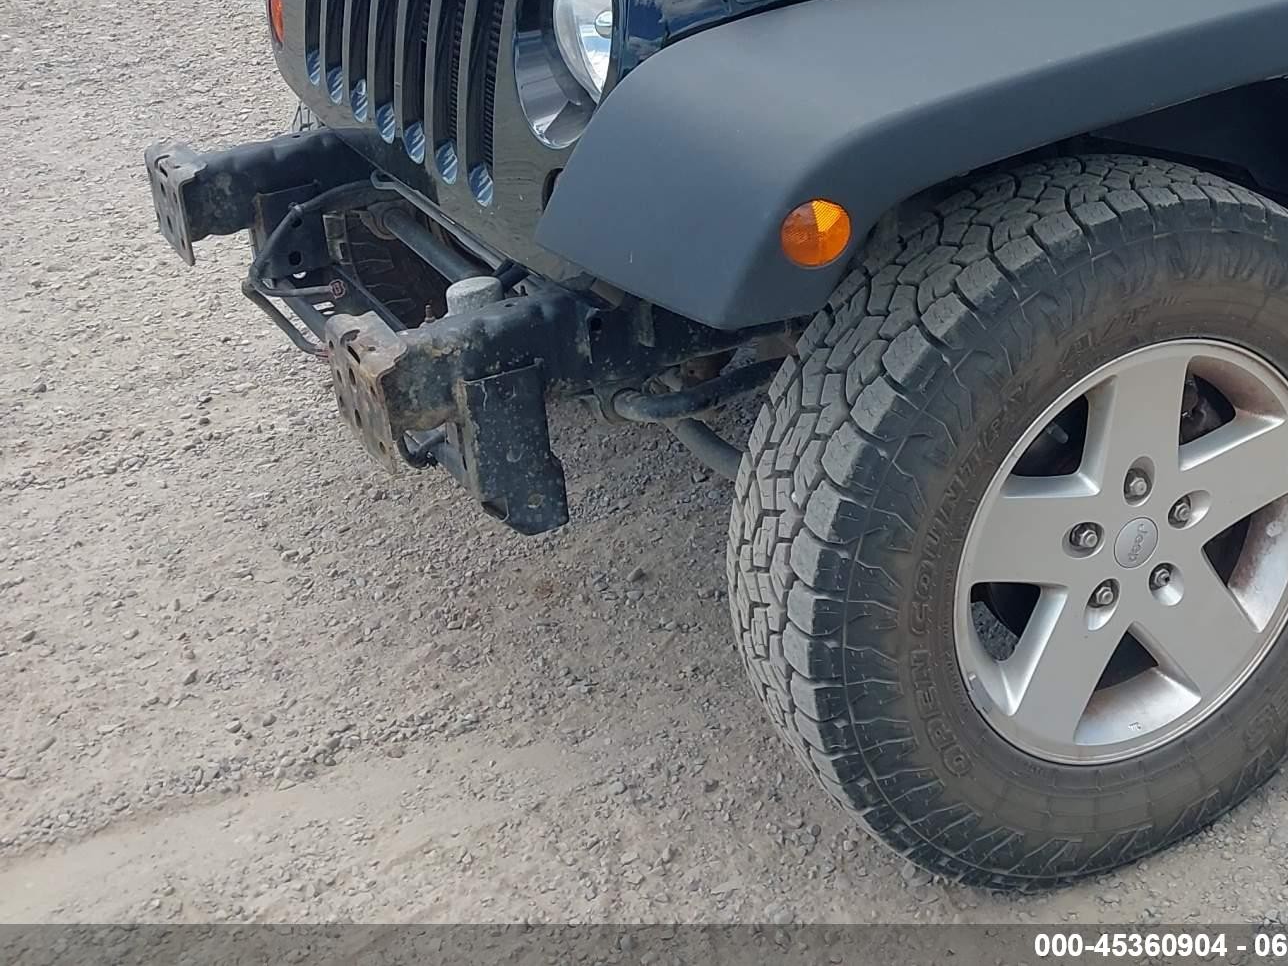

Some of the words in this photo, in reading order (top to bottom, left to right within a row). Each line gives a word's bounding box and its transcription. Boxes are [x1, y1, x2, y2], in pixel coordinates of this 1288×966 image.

[909, 377, 1036, 640] COUNTRY
[1128, 523, 1148, 562] Jeep
[907, 642, 976, 784] OPEN
